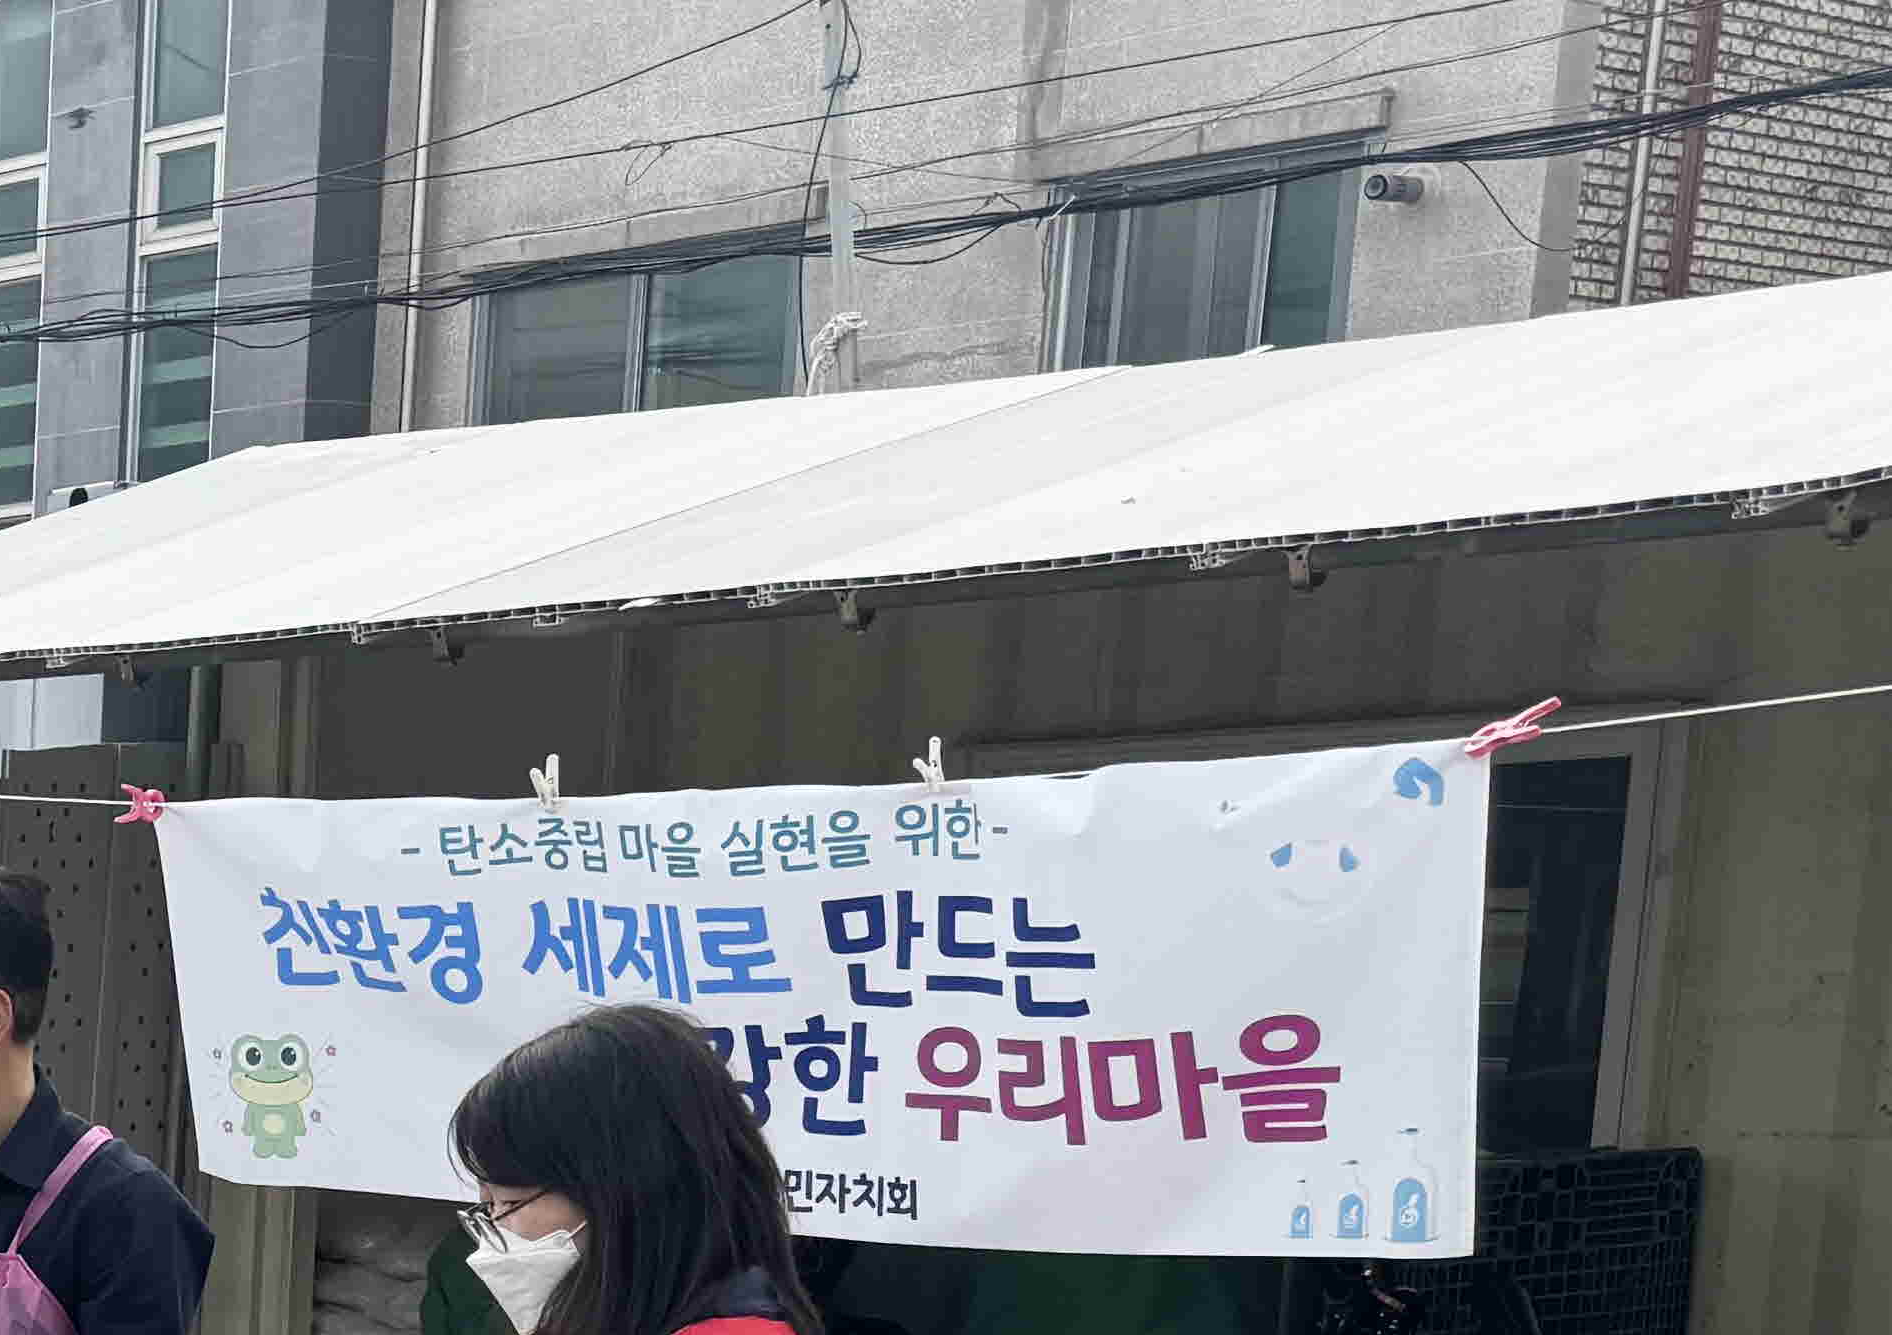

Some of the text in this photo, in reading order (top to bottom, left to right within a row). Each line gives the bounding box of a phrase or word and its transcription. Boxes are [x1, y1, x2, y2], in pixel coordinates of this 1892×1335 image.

[439, 816, 609, 878] 탄소중립
[619, 819, 703, 879] 마을
[720, 808, 873, 878] 실현을
[894, 798, 983, 862] 위한
[258, 886, 1097, 1019] 친환경 세제로 만드는
[904, 1012, 1343, 1147] 우리마을
